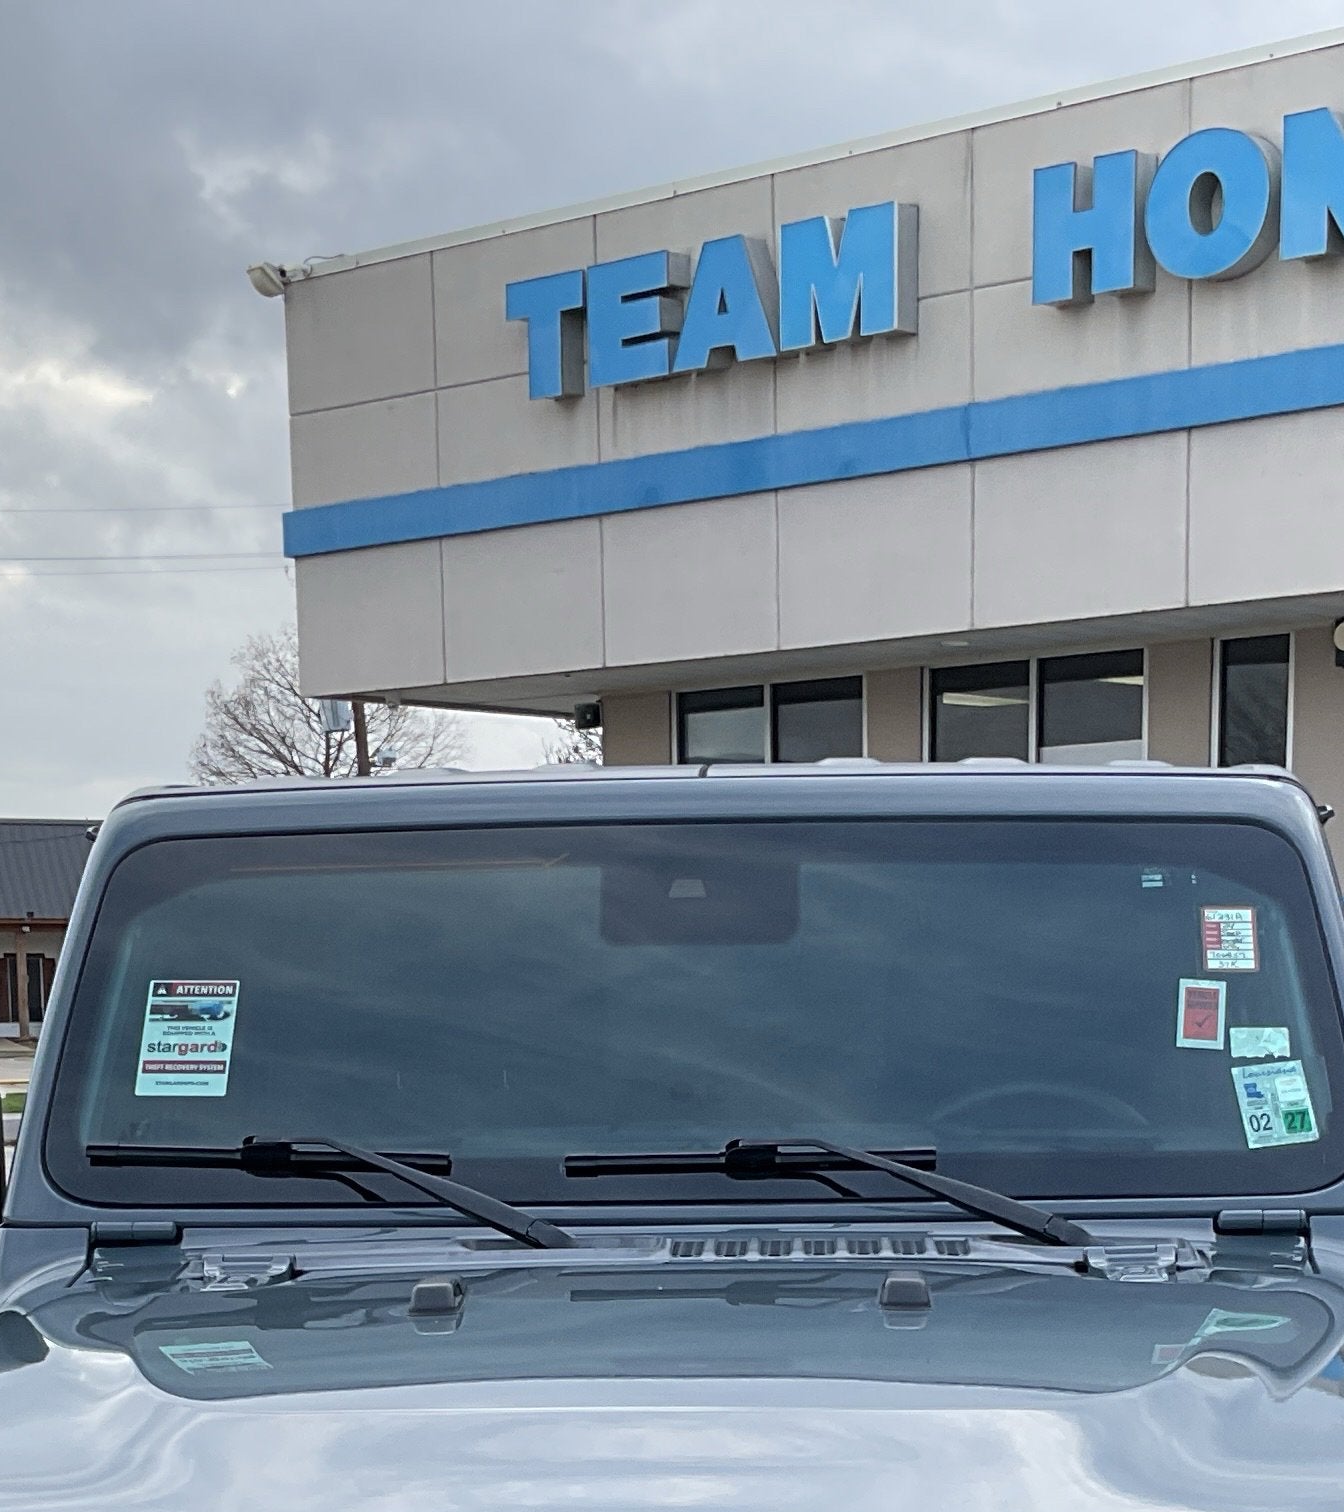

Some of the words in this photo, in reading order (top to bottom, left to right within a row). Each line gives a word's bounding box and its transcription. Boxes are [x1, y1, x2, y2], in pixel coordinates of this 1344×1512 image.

[505, 200, 918, 400] TEAM
[176, 985, 234, 995] ATTENTION
[147, 1040, 218, 1056] stargard
[1249, 1113, 1273, 1133] 02
[1284, 1111, 1307, 1131] 27
